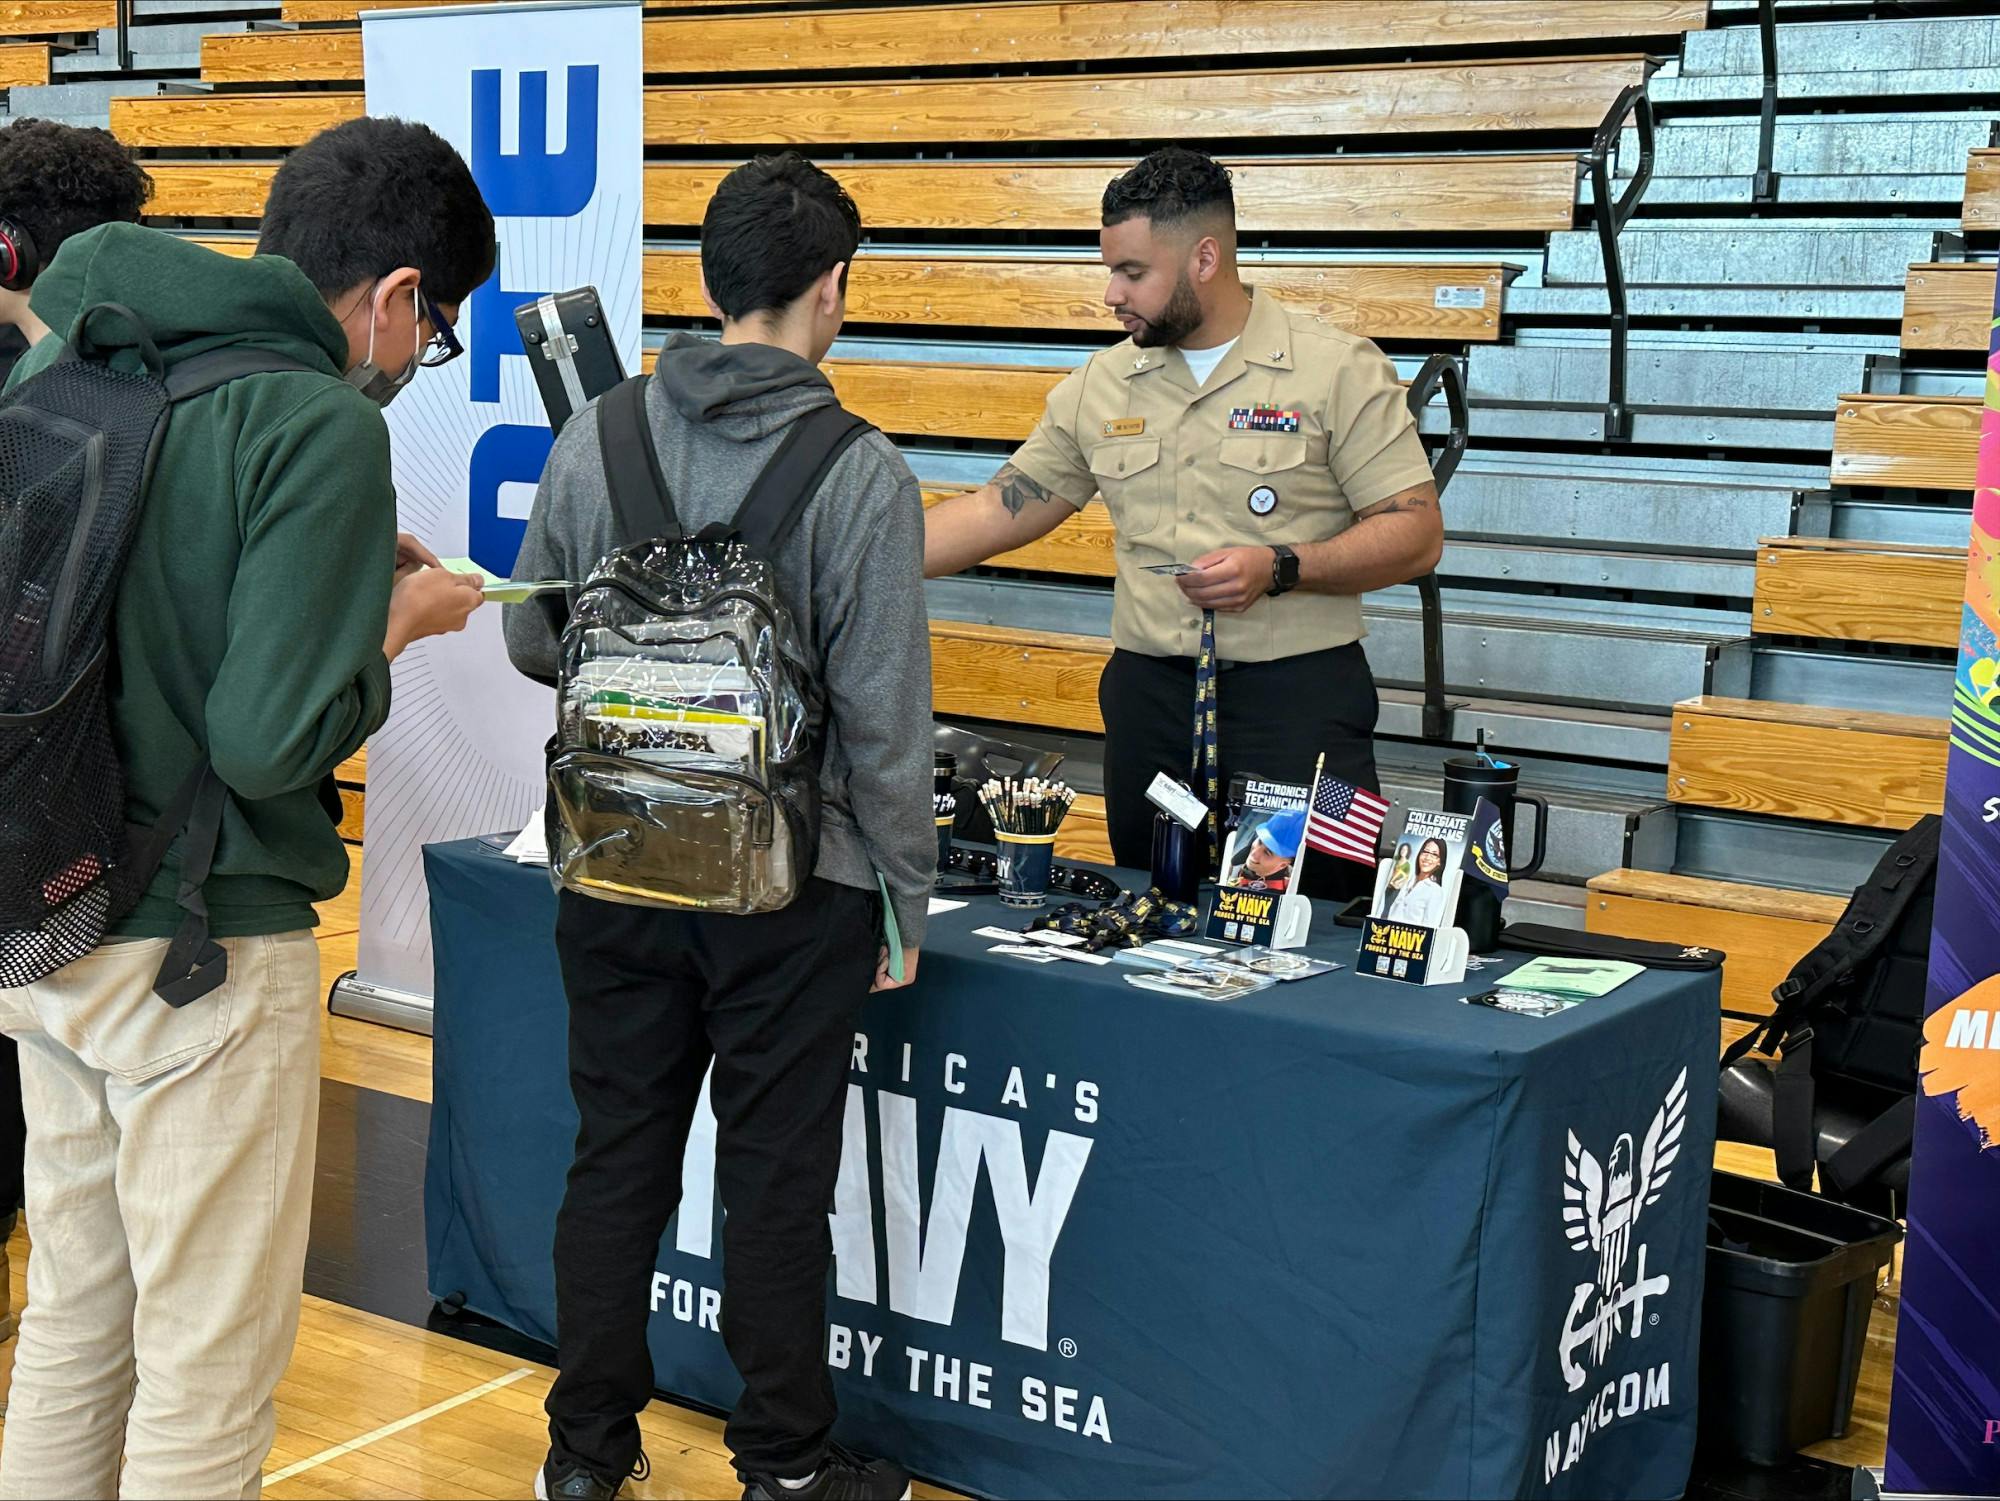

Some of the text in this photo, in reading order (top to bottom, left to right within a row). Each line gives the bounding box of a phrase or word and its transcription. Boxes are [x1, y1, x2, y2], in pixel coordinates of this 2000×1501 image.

[1246, 780, 1308, 799] ELECTRONICS
[1244, 792, 1306, 812] TECHNICIAN
[1408, 811, 1468, 831] COLLEGIATE
[1404, 822, 1464, 843] PROGRAMS
[1236, 896, 1273, 918] NAVY
[1388, 928, 1426, 952] NAVY
[850, 1032, 1099, 1123] RICA'S
[650, 1271, 1112, 1444] FOR BY THE SEA
